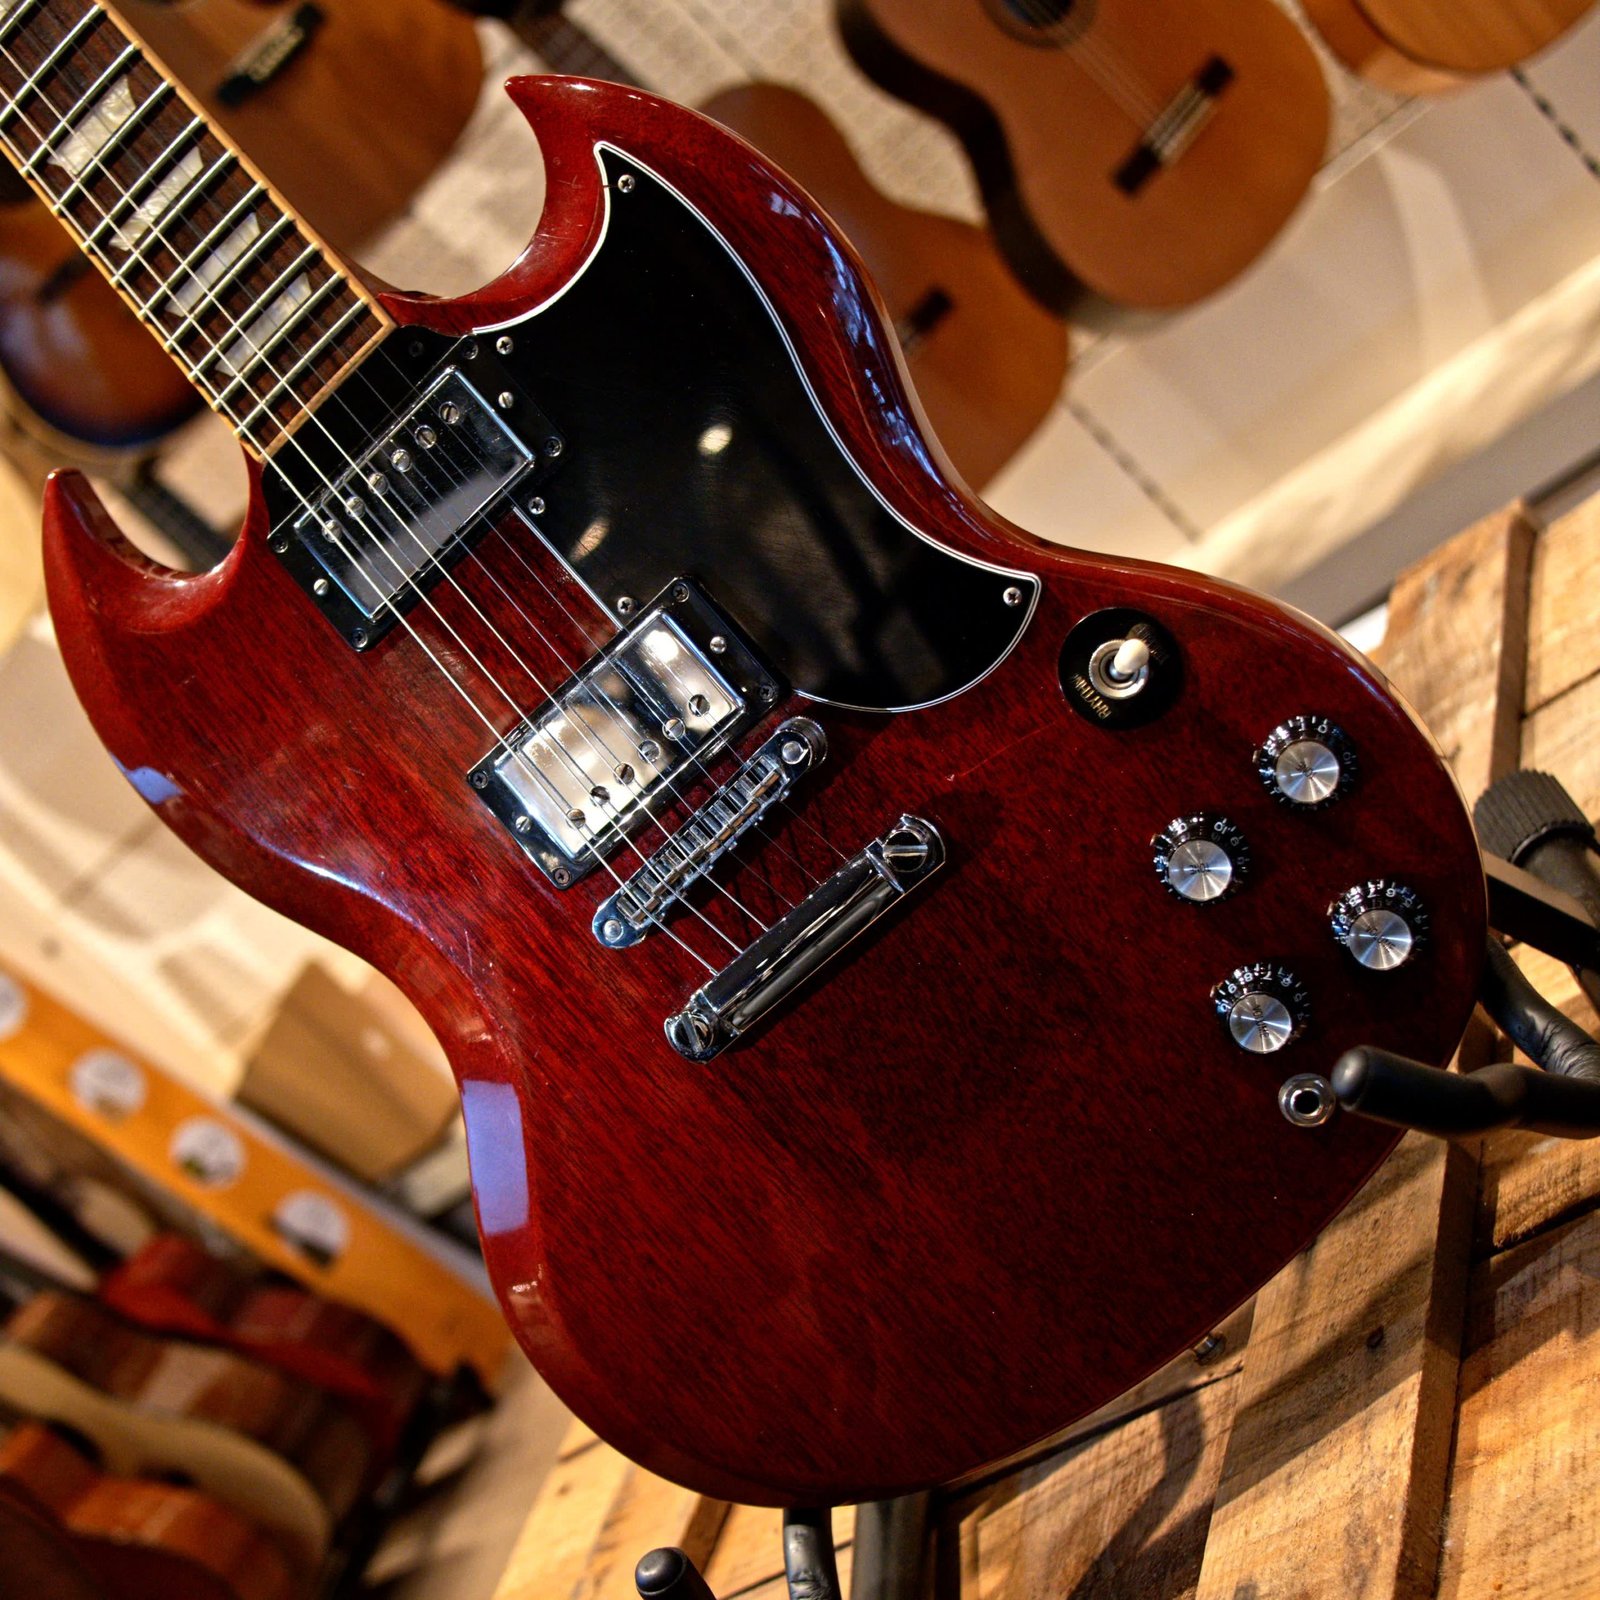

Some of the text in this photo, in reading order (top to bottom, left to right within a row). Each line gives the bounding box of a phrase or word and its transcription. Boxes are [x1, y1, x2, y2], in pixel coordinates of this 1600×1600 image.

[1386, 887, 1396, 897] 6
[1243, 972, 1254, 983] 8
[1262, 970, 1273, 981] 7
[1227, 983, 1238, 994] 9
[1252, 1005, 1271, 1038] VOLUME
